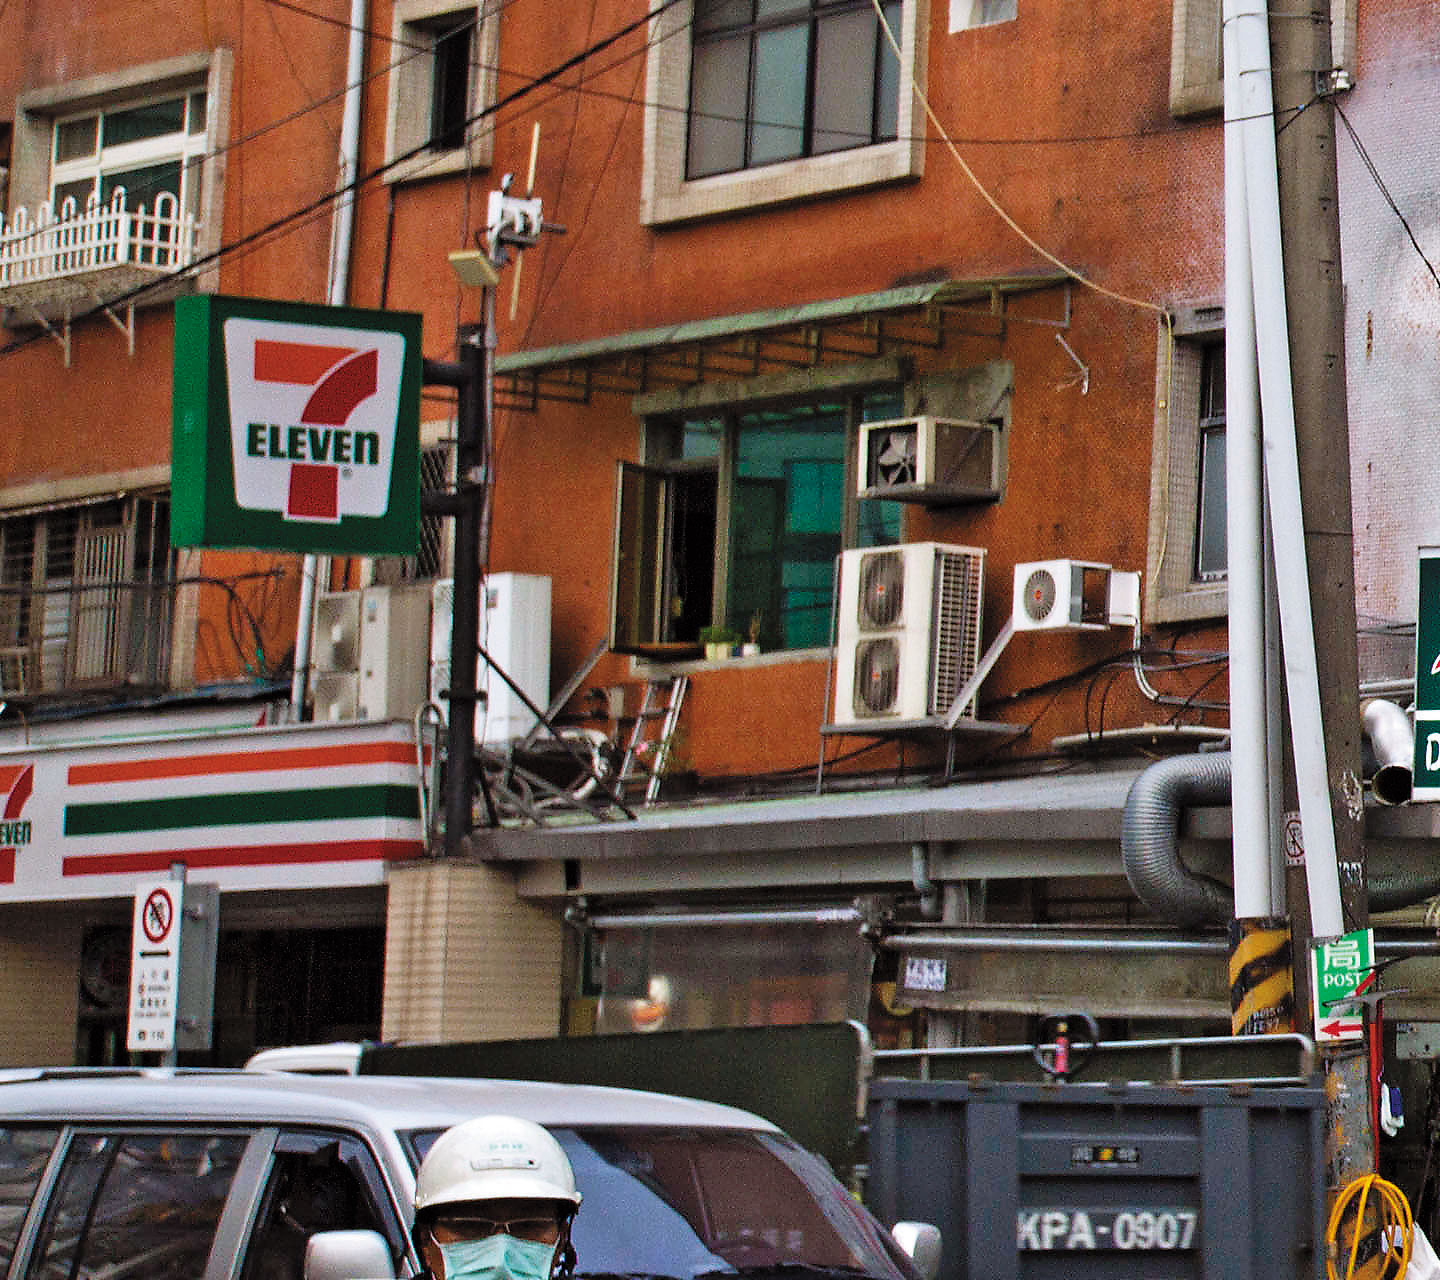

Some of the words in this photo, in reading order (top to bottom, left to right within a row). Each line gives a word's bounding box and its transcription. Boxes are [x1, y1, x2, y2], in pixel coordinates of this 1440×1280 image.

[246, 422, 380, 466] ELEVEN
[1323, 939, 1361, 971] 局
[1323, 972, 1362, 989] POST
[1017, 1212, 1198, 1250] KPA-0907
